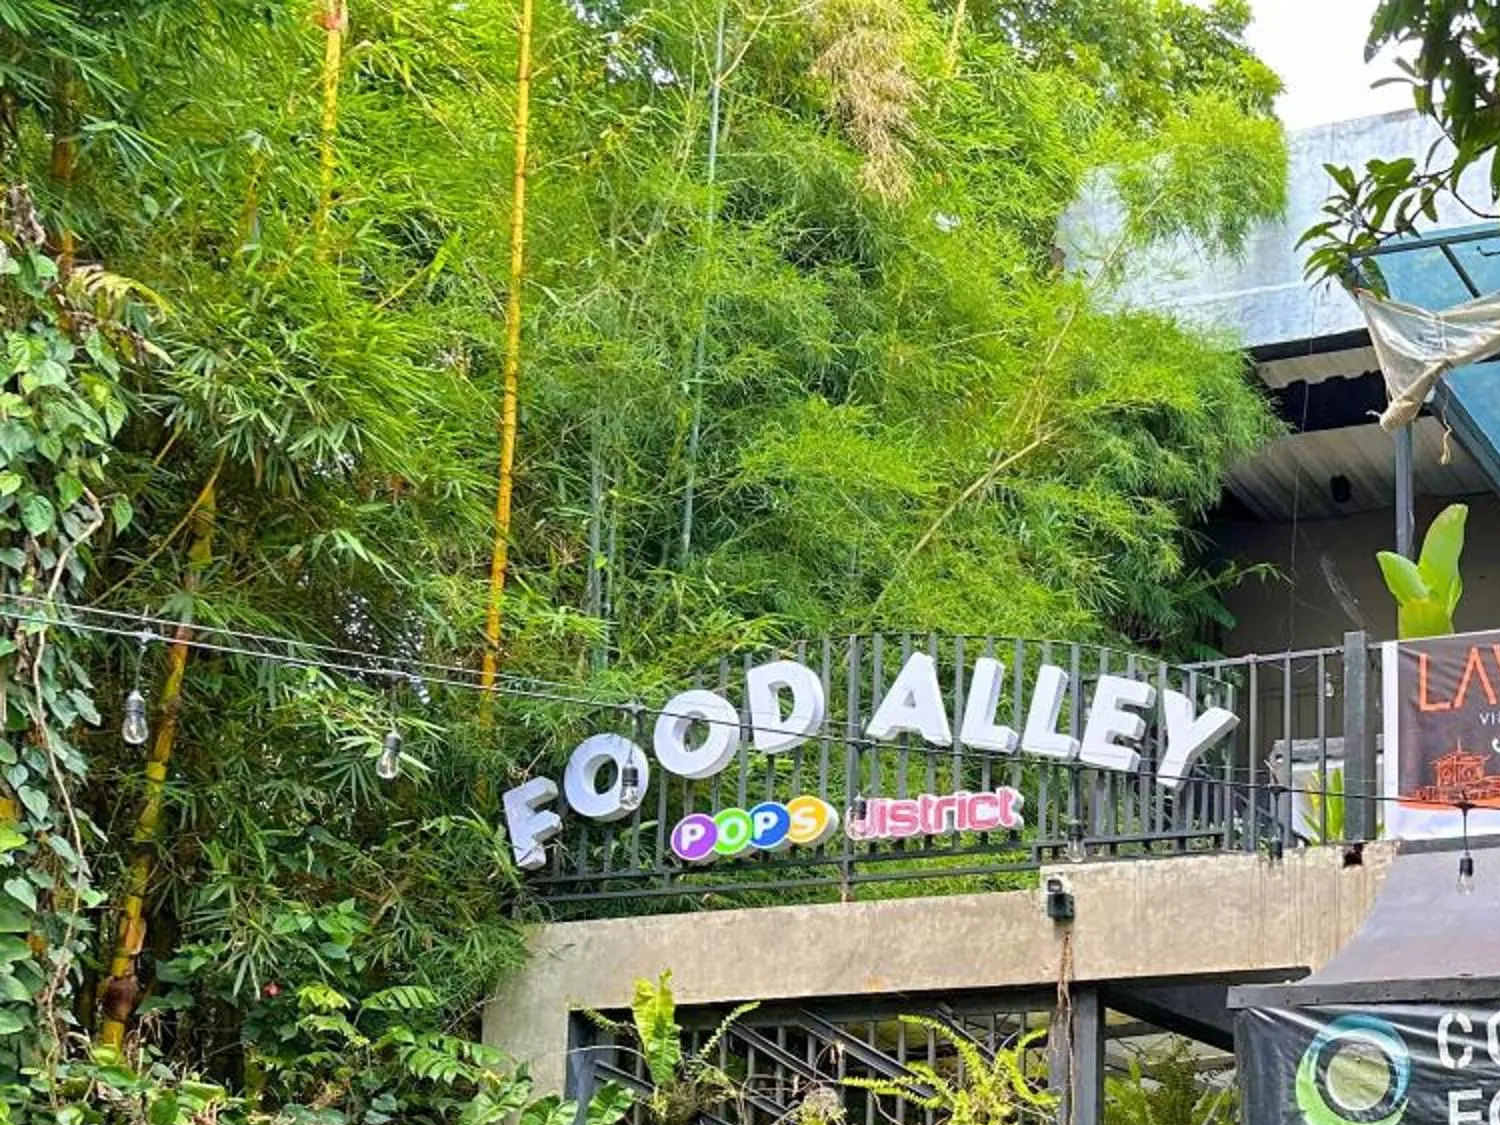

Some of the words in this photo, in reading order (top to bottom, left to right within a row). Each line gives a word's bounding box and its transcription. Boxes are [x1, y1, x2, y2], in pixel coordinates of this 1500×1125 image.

[503, 660, 824, 870] FOOD
[866, 652, 1240, 791] ALLEY
[675, 799, 830, 858] POPS
